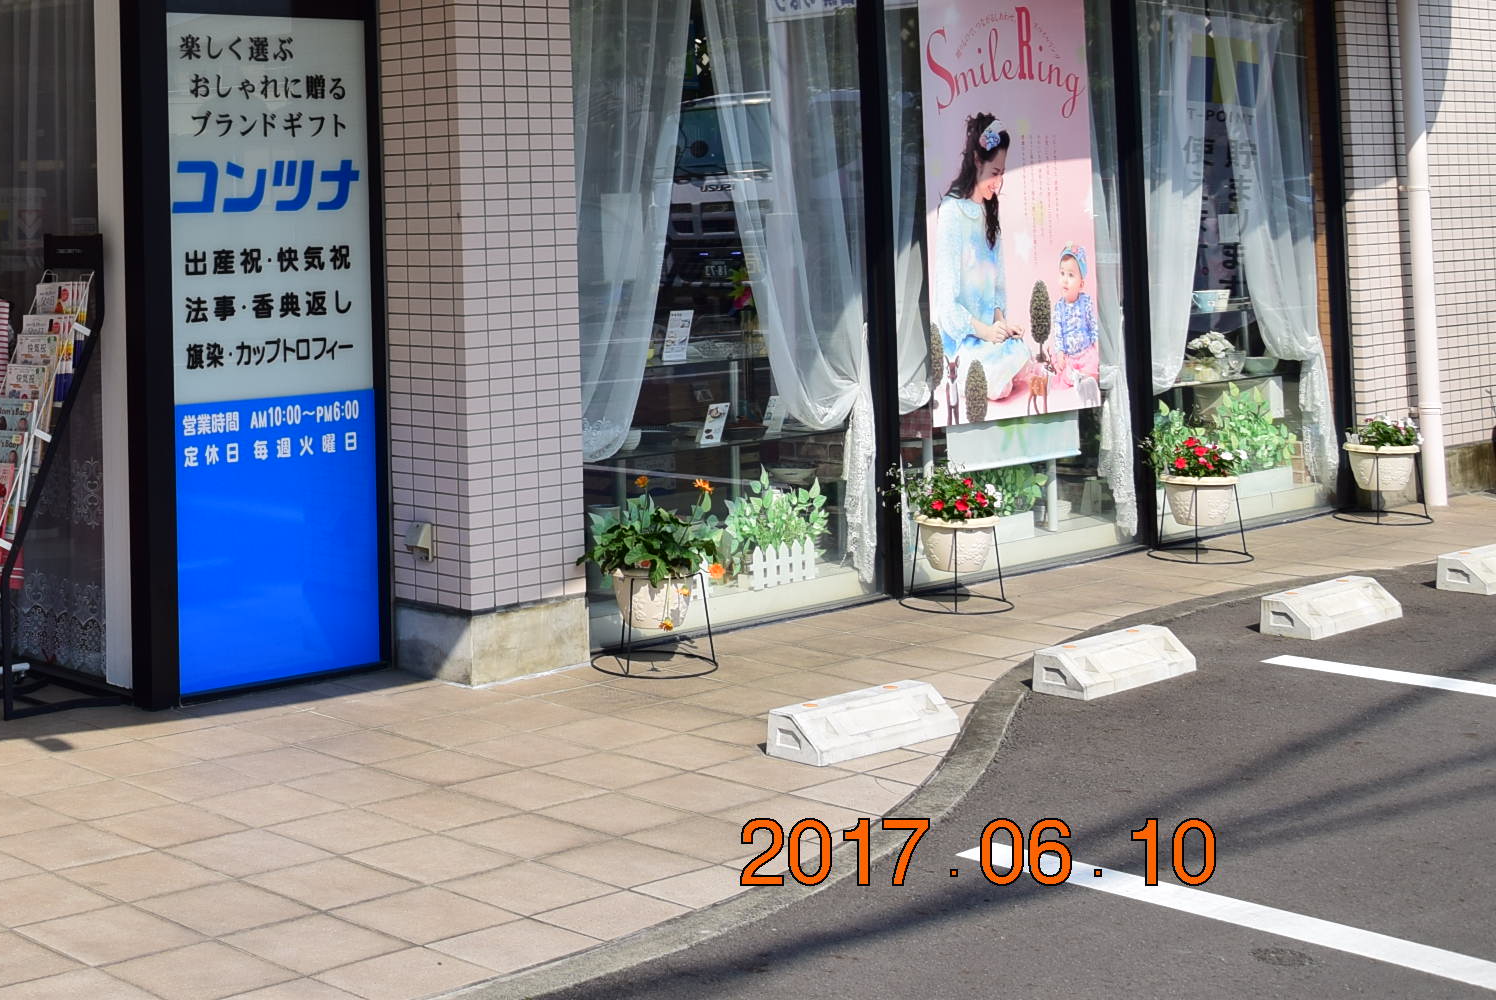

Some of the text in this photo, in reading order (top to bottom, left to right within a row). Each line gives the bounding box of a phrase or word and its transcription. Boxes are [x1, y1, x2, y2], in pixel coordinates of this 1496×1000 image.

[179, 33, 295, 62] 楽しく選ぶ
[189, 74, 347, 101] おしゃれに贈る
[190, 111, 347, 138] ブランドギフト
[171, 159, 360, 214] コンツナ
[184, 245, 352, 276] 出産祝・快気祝
[185, 290, 352, 324] 法事・香典返し
[186, 337, 354, 370] 旗染・カップトロフィー
[182, 411, 240, 437] 営業時間
[184, 432, 358, 468] 定休日 毎週火曜日
